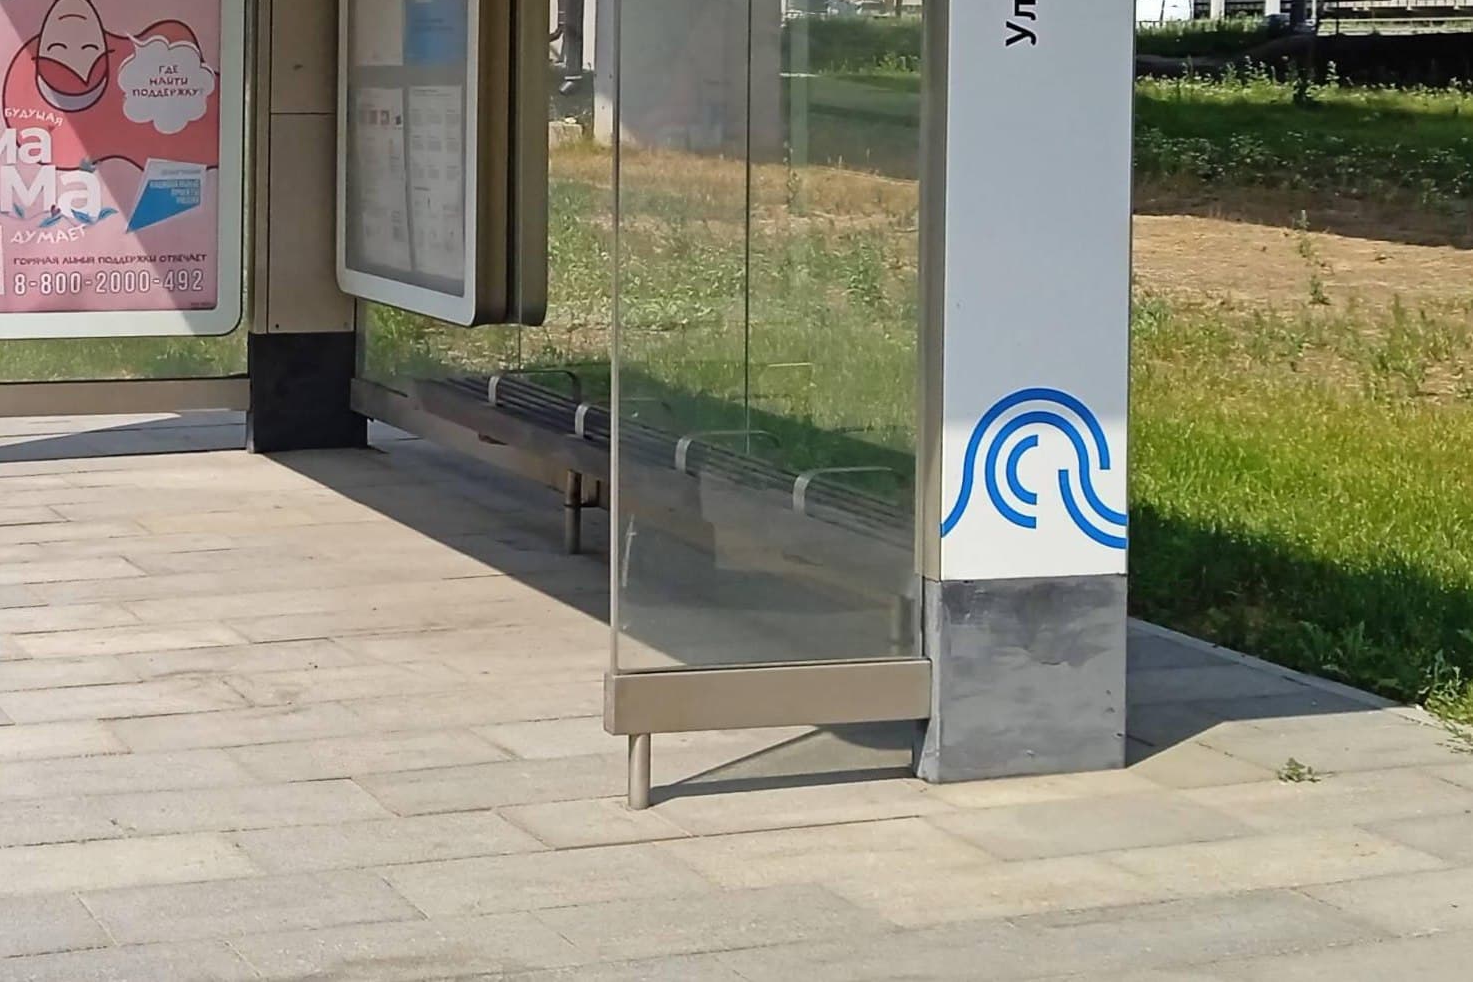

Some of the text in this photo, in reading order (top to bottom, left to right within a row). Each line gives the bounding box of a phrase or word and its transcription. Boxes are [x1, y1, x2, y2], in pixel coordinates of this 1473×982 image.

[158, 65, 179, 74] ГДЕ
[11, 224, 87, 244] ДУМАЕТ
[13, 269, 204, 295] 8-800-2000-492
